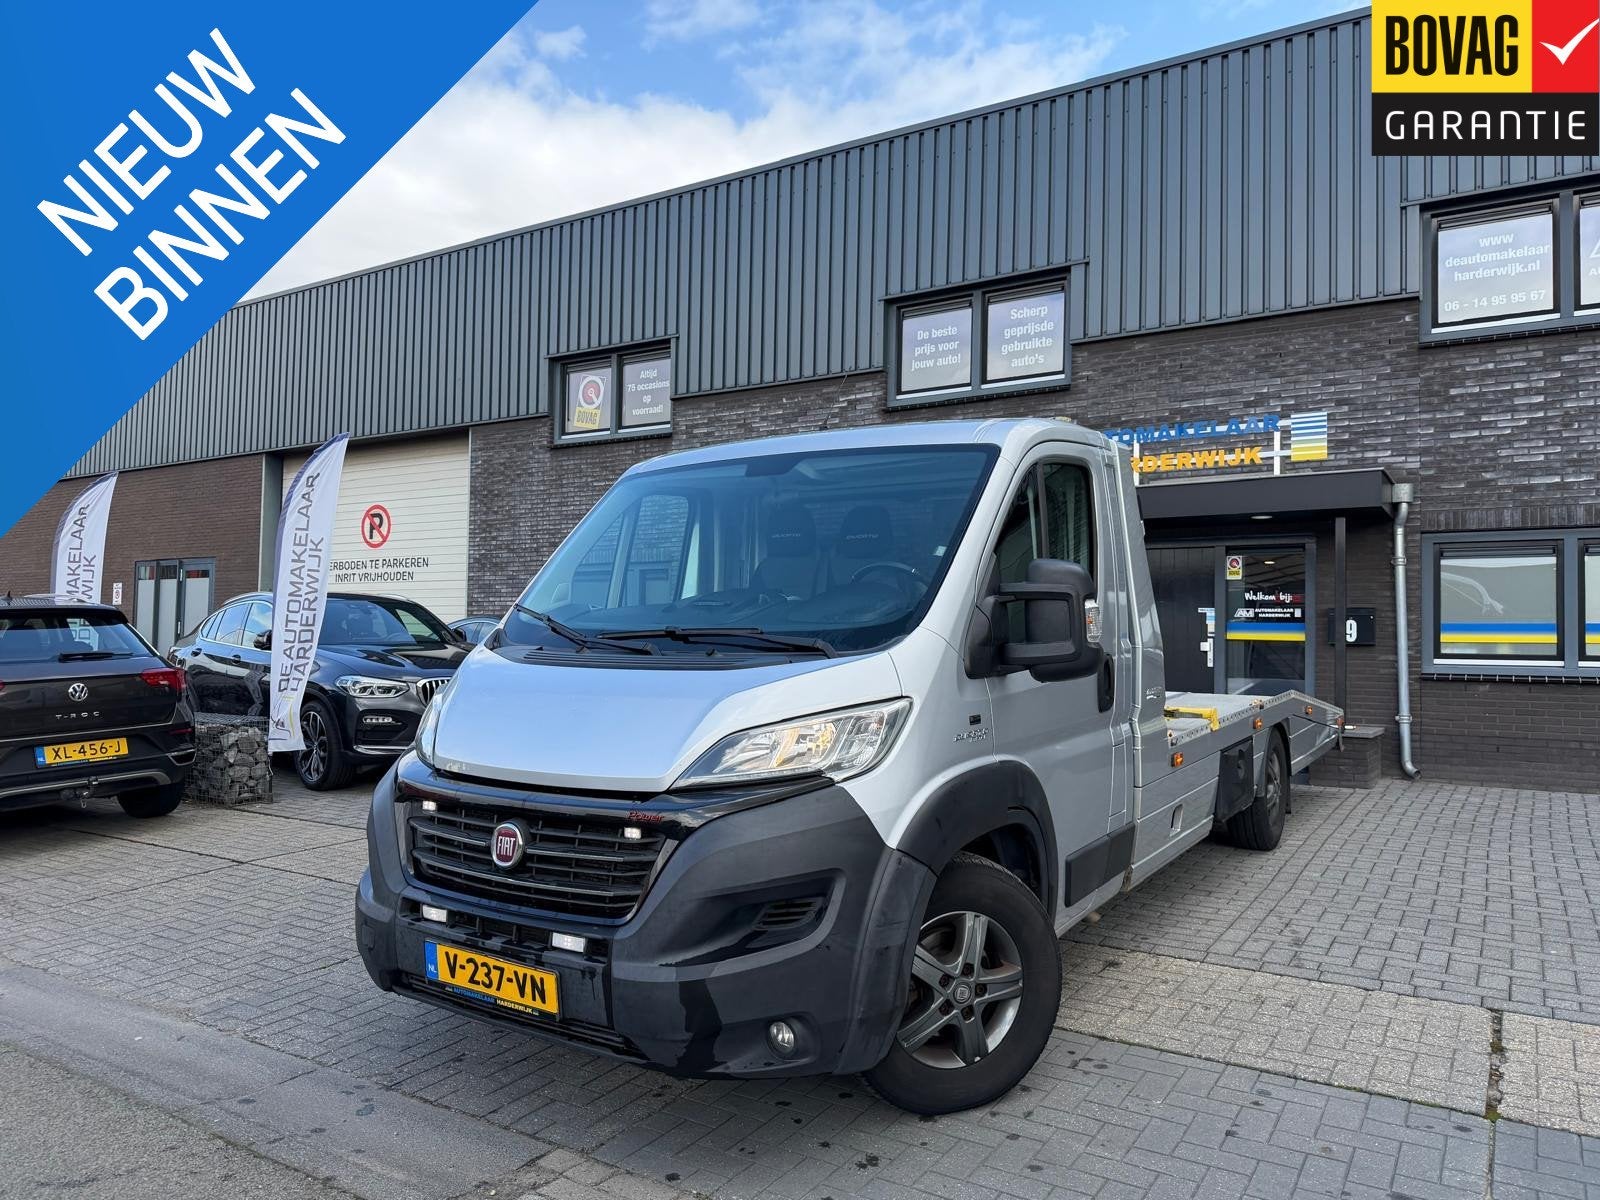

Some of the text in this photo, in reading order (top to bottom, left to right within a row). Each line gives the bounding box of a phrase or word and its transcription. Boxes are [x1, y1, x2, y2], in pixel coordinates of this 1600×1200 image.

[1479, 233, 1514, 247] www
[1445, 244, 1551, 268] deautomakelaar
[1454, 260, 1541, 281] harderwijk.nl
[1444, 301, 1460, 311] 06
[1472, 297, 1487, 308] 14
[1491, 294, 1506, 305] 95
[1511, 292, 1526, 303] 95
[1530, 289, 1546, 301] 67
[1010, 305, 1048, 320] Scherp
[917, 325, 958, 340] De beste
[1004, 319, 1054, 339] geprijsde
[914, 340, 960, 357] prijs voor
[1001, 335, 1053, 356] gebruikte
[911, 353, 961, 371] jouw auto!
[1011, 353, 1045, 368] auto's
[640, 369, 658, 380] Altijd
[637, 379, 670, 391] occasions
[642, 395, 652, 404] op
[369, 559, 379, 569] TE
[381, 557, 429, 569] PARKEREN
[335, 571, 414, 583] INRIT VRIJHOUDEN
[1244, 590, 1276, 601] Welkom
[290, 537, 324, 691] HARDERWIJK
[1345, 619, 1357, 643] 9
[52, 740, 121, 761] XL-456-J
[497, 835, 516, 857] FIAT
[428, 951, 547, 1005] NL V-237-VN
[453, 986, 495, 1003] AUTOMAKELAAR
[496, 999, 533, 1015] HARDERWIJK
